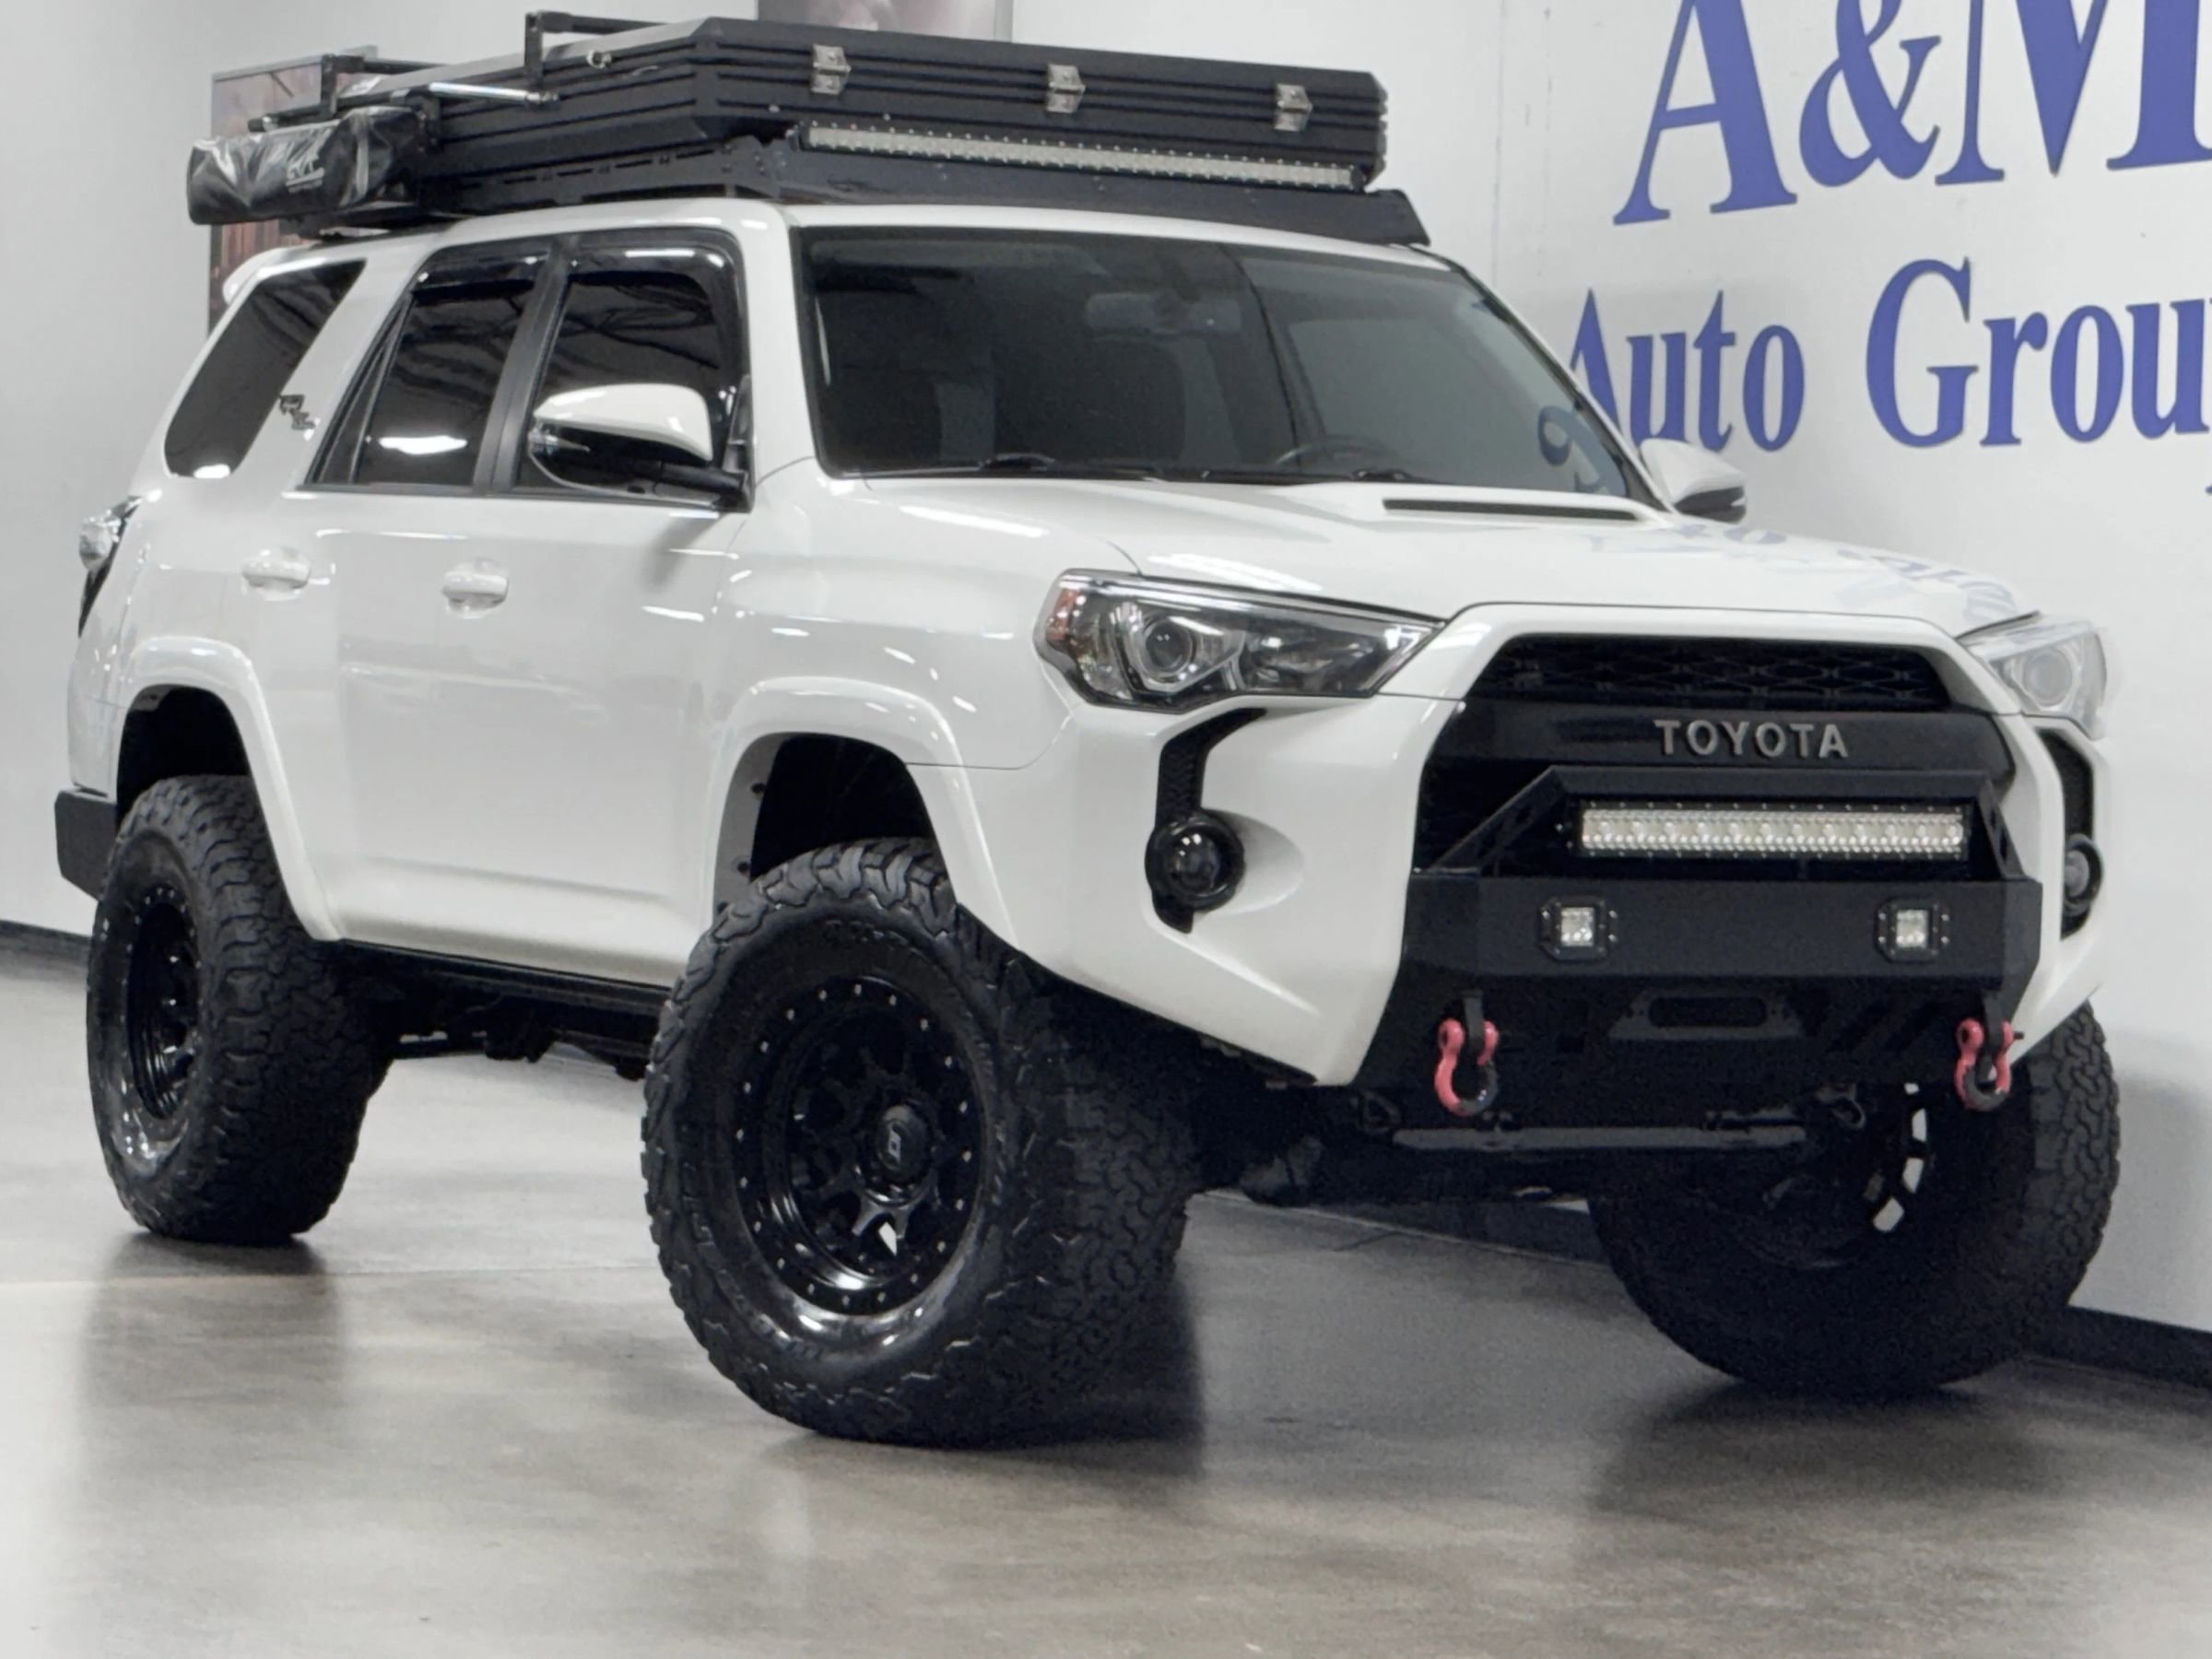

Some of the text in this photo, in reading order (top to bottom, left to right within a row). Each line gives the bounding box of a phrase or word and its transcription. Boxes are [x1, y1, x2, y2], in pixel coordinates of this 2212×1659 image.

[1613, 0, 2212, 225] A&M
[1570, 256, 2212, 453] Auto Grou
[1653, 719, 1849, 759] TOYOTA
